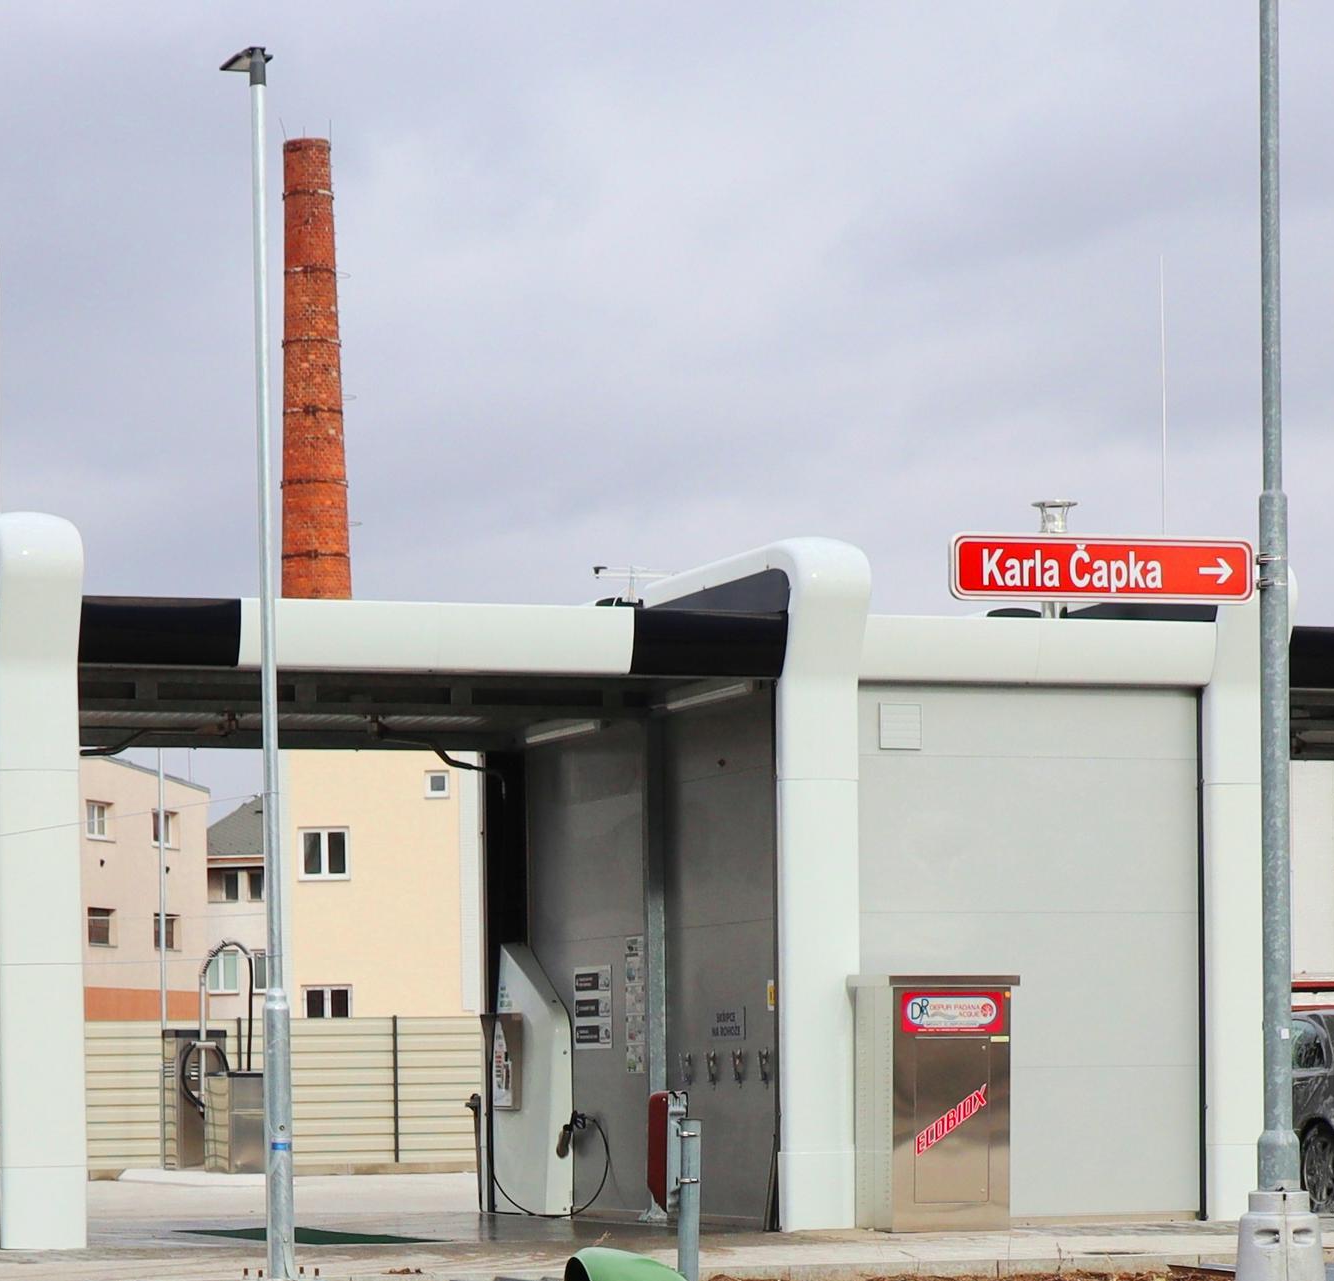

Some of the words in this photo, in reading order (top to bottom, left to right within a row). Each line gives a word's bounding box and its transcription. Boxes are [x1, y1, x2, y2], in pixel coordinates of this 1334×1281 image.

[982, 548, 1060, 588] Karla
[1069, 543, 1163, 593] Čapka
[916, 1083, 987, 1157] ECOBIOX
